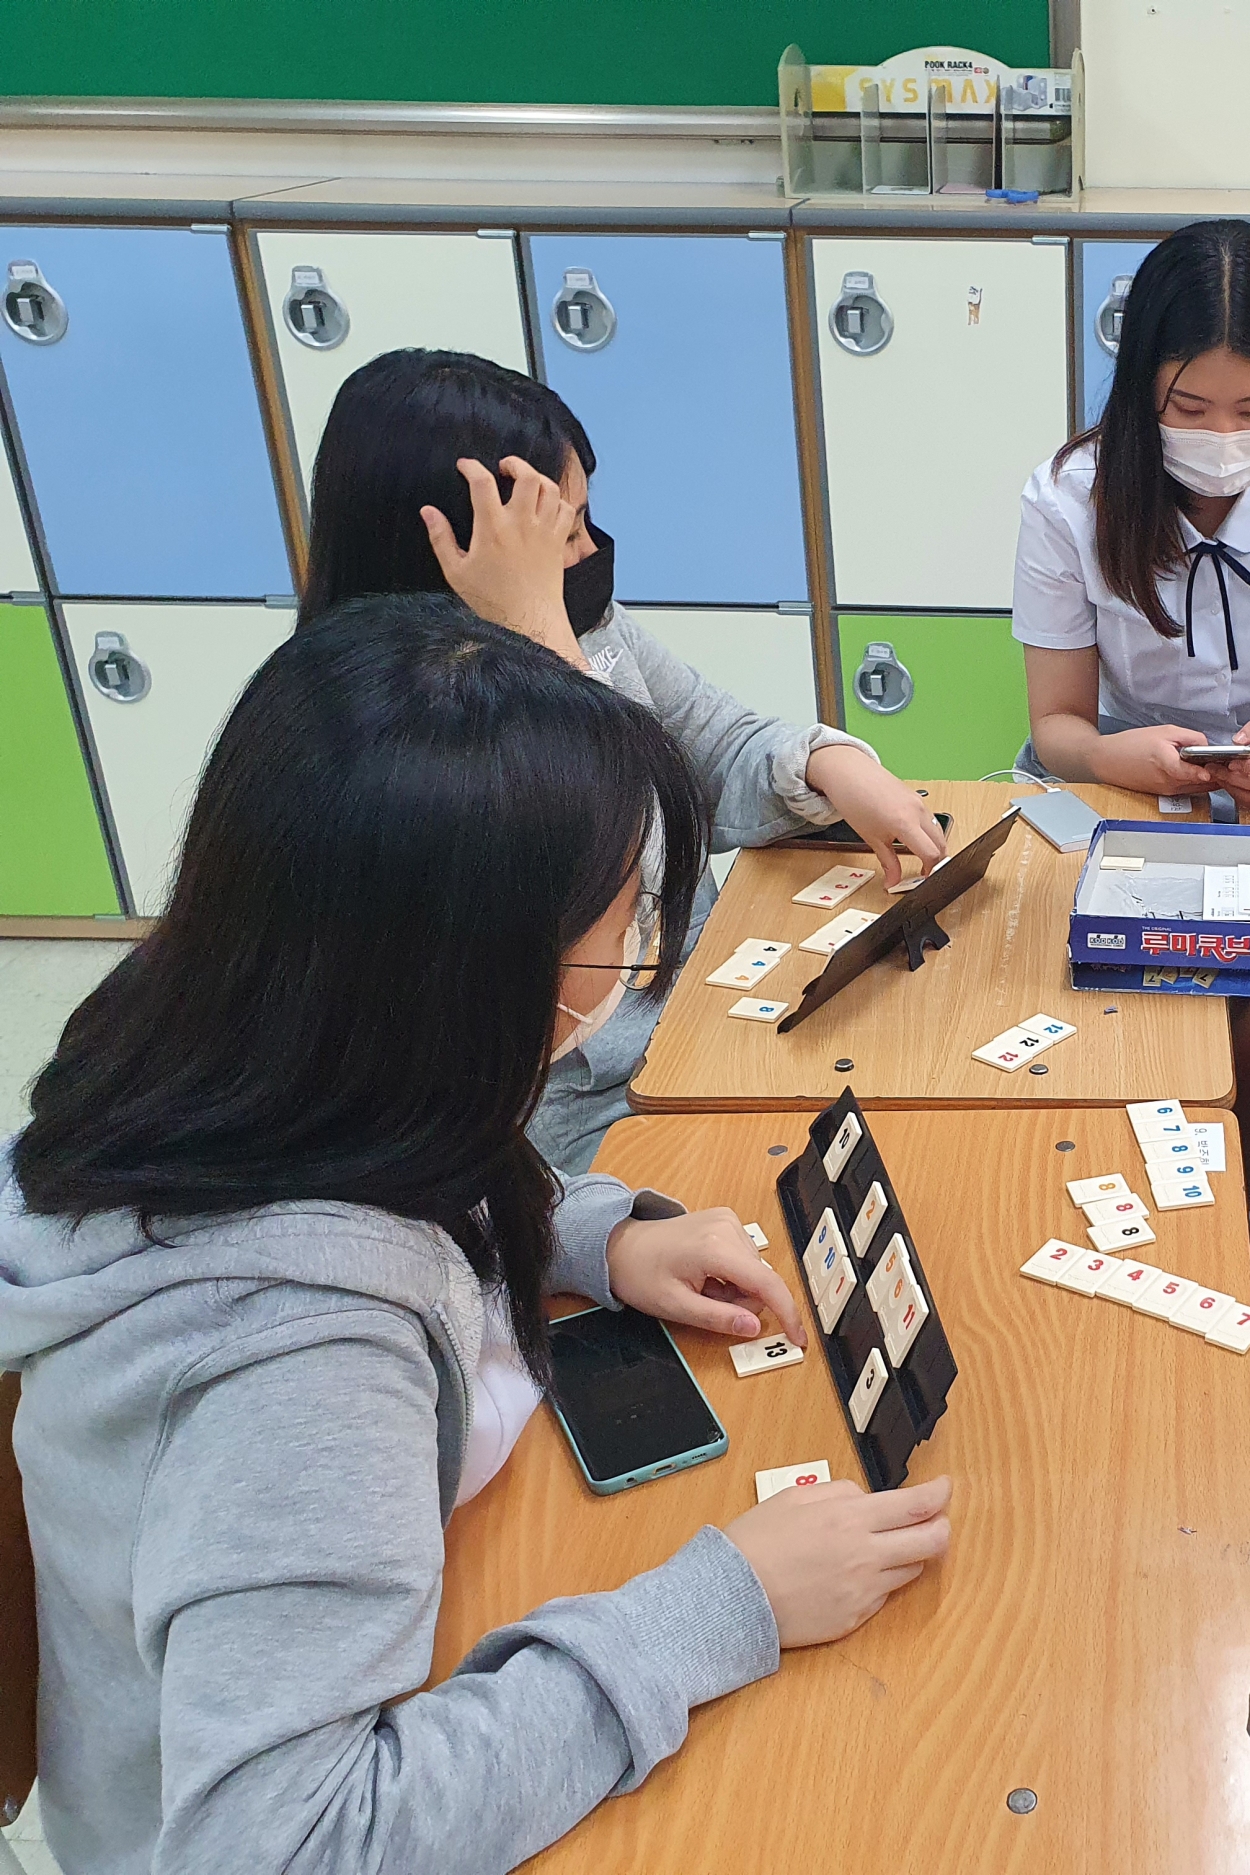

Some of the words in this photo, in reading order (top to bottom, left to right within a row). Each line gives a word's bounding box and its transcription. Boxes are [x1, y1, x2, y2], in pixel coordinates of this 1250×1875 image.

[1044, 1023, 1064, 1034] 12
[1020, 1037, 1040, 1047] 12
[998, 1051, 1019, 1062] 12
[1164, 1124, 1181, 1132] 7
[838, 1127, 850, 1149] 10
[1172, 1144, 1189, 1153] 8
[1177, 1165, 1195, 1174] 9
[1099, 1182, 1117, 1191] 8
[1183, 1185, 1203, 1198] 10
[865, 1200, 876, 1221] 2
[1116, 1202, 1134, 1212] 8
[818, 1226, 827, 1244] 9
[1122, 1226, 1140, 1236] 8
[824, 1246, 836, 1270] 10
[1050, 1247, 1068, 1261] 2
[885, 1252, 897, 1273] 5
[1088, 1259, 1104, 1271] 3
[1127, 1269, 1144, 1282] 4
[835, 1276, 845, 1295] 1
[893, 1278, 903, 1299] 6
[1163, 1281, 1180, 1295] 5
[1200, 1296, 1216, 1310] 6
[902, 1303, 916, 1331] 11
[764, 1341, 788, 1358] 13
[865, 1368, 875, 1390] 3
